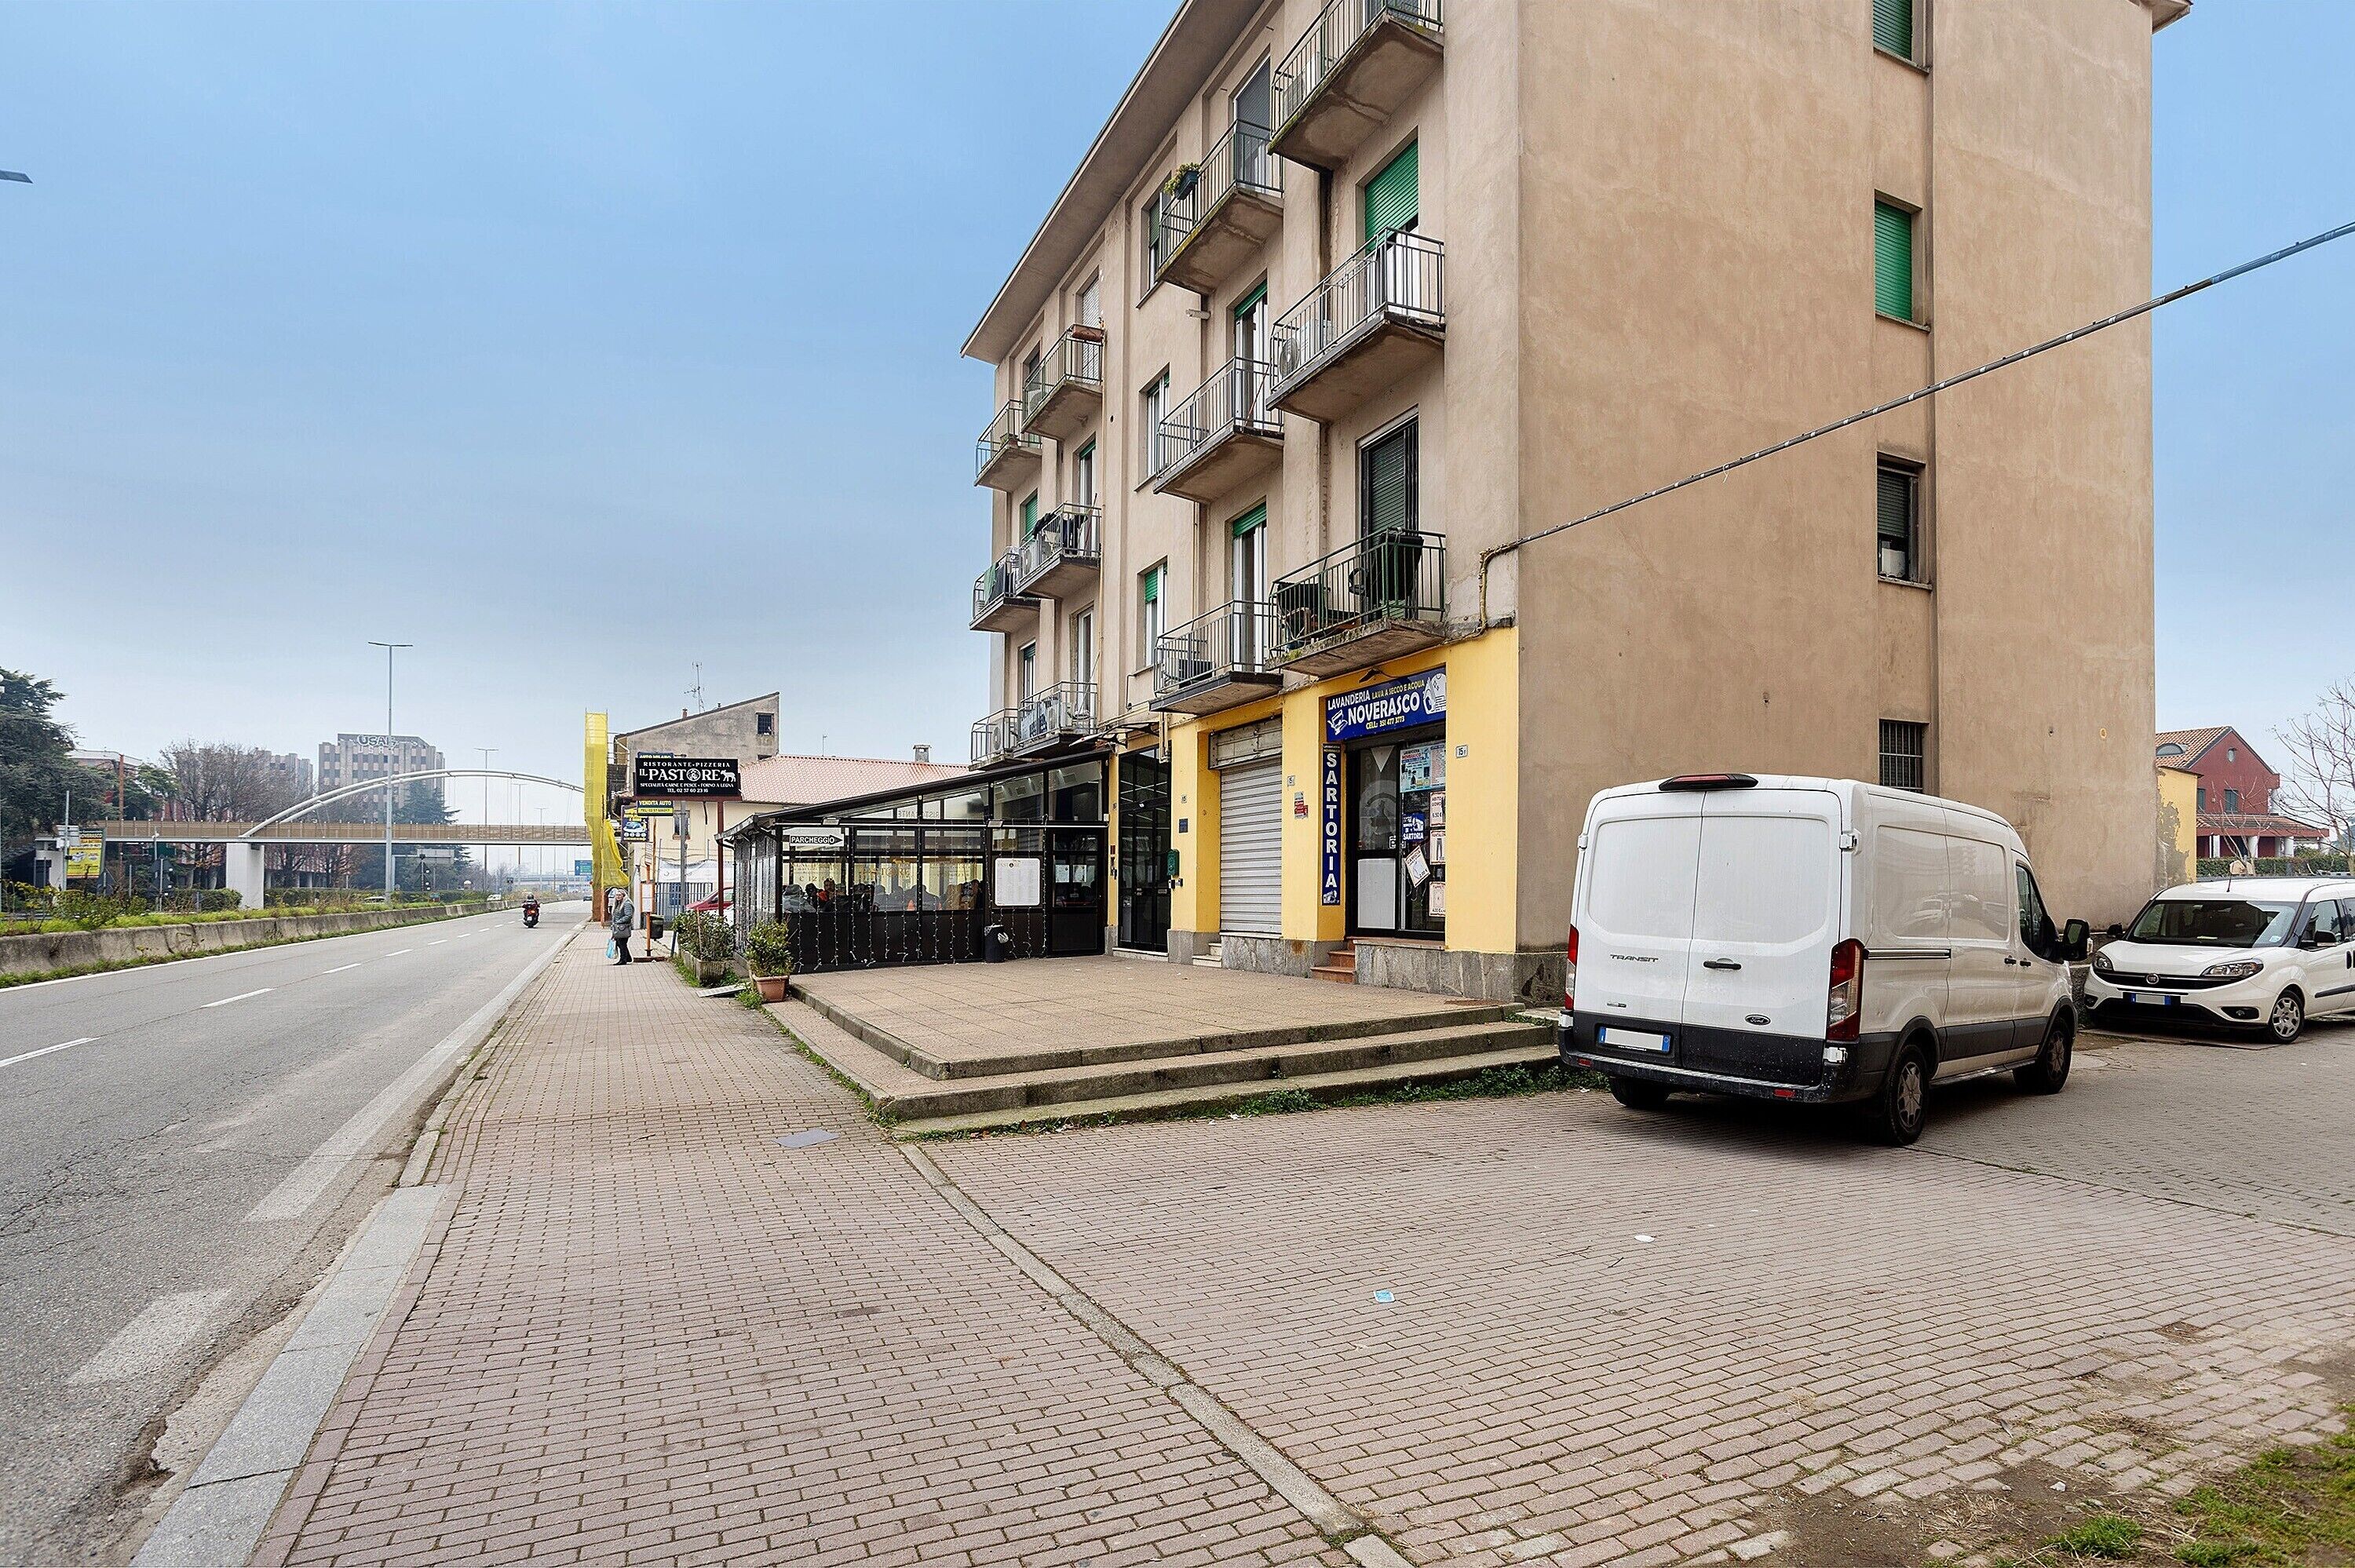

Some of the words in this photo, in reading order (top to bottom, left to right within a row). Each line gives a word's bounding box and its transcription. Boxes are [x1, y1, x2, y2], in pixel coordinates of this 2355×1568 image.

[1327, 690, 1371, 711] LAVANDERIA
[1371, 690, 1384, 699] LAVA
[1389, 684, 1404, 695] SECCO
[1408, 680, 1425, 691] ACQUA
[1348, 691, 1420, 725] NOVERASCO
[648, 768, 721, 782] PASTORE
[1325, 753, 1338, 888] SARTORIA
[1609, 954, 1659, 963] TRANSIT
